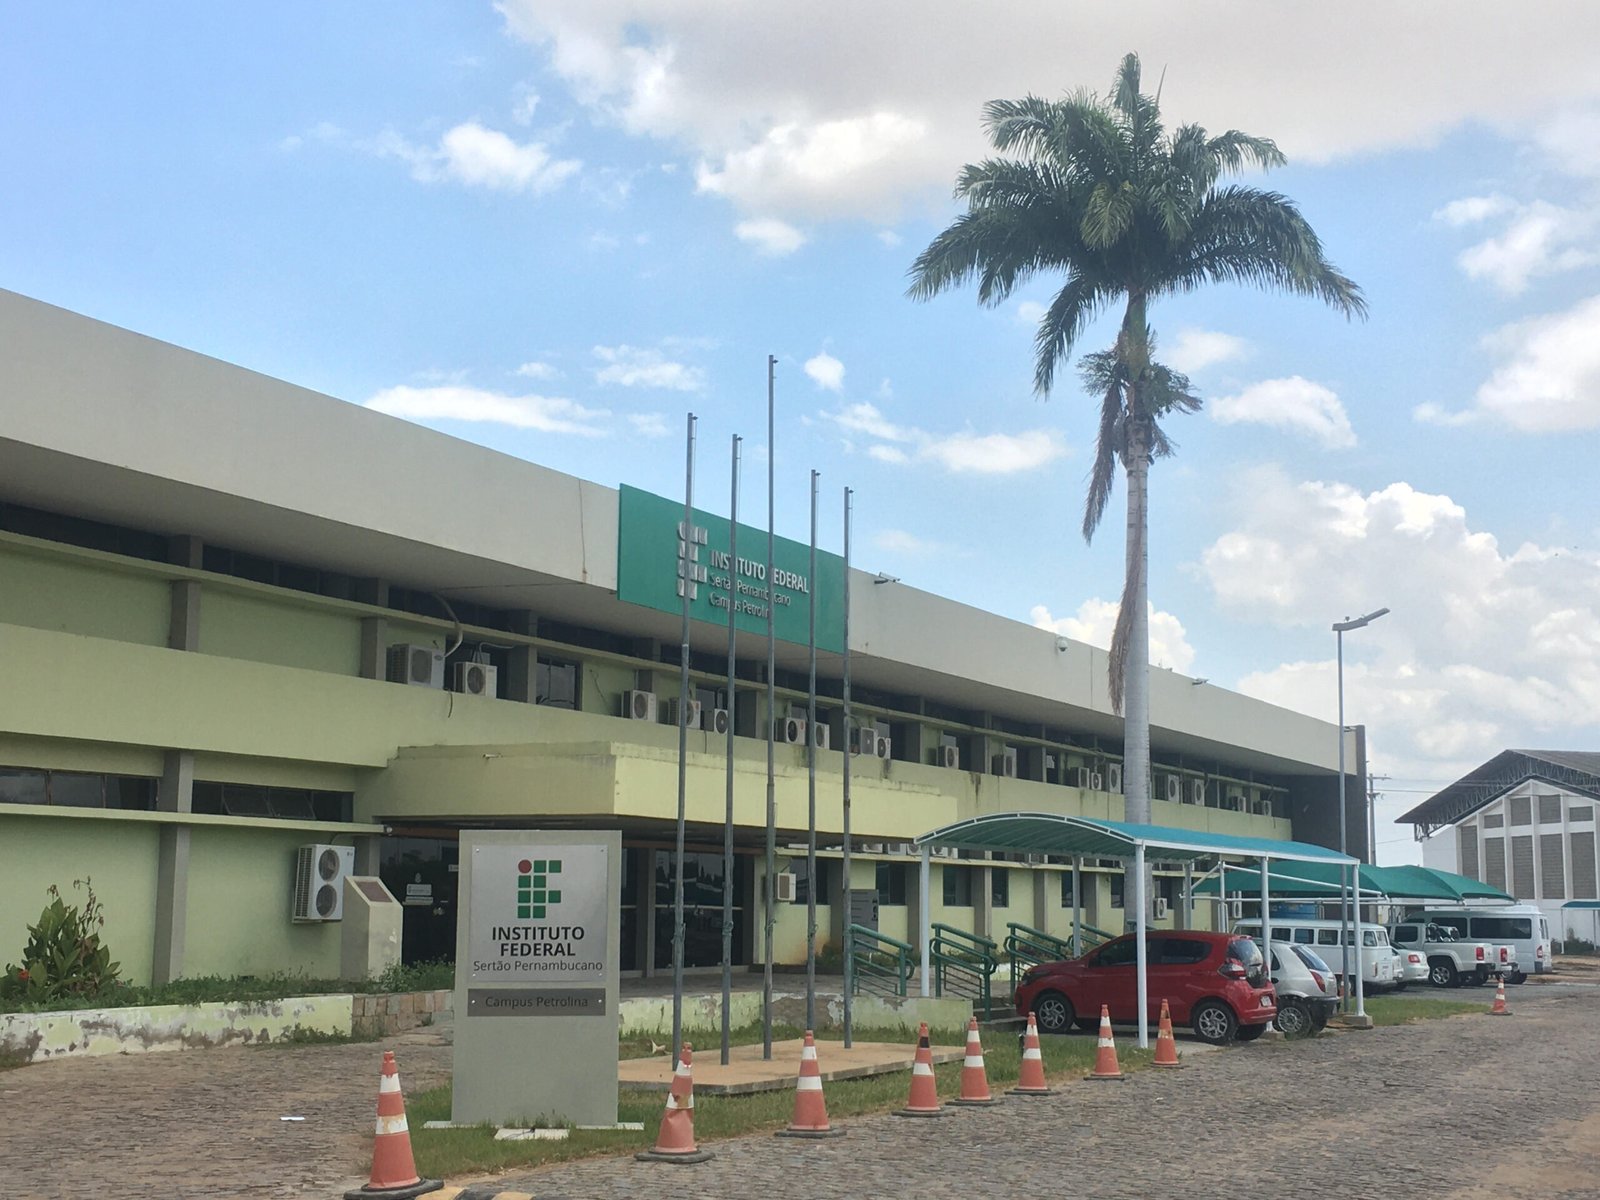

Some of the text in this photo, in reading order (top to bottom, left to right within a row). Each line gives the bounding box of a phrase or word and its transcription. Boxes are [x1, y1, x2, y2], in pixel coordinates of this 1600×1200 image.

[711, 550, 809, 594] INSITUTO EDERAL
[710, 573, 791, 606] Sertã Pernambcano
[742, 600, 772, 618] Petroli
[492, 926, 585, 941] INSTITUTO
[500, 943, 576, 956] FEDERAL
[473, 960, 603, 972] Sertão Pernambucano
[485, 995, 588, 1010] Campus Petrolina
